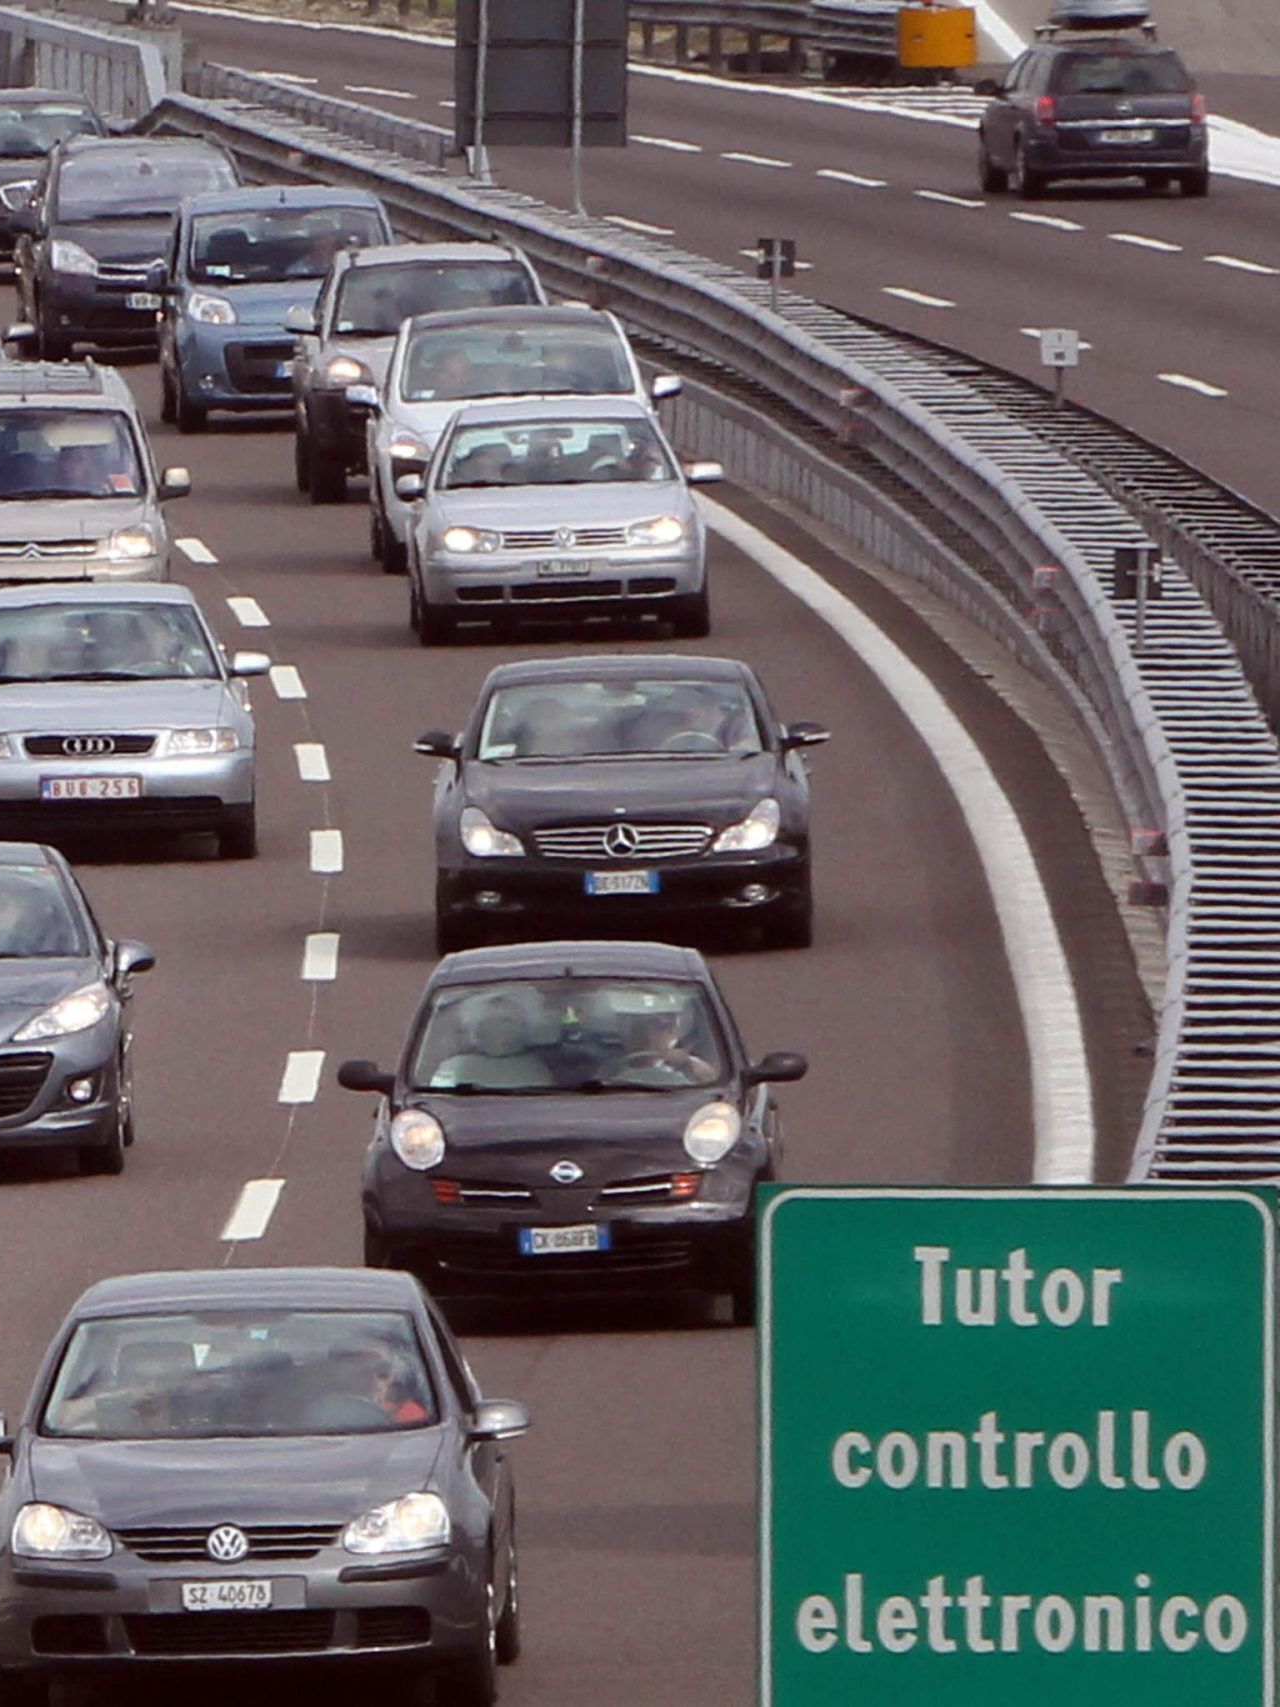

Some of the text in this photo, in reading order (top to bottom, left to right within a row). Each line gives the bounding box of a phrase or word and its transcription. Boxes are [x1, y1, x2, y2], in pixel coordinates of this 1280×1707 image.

[913, 1245, 1124, 1328] Tutor
[830, 1409, 1207, 1491] controllo
[795, 1572, 1249, 1654] elettronico
